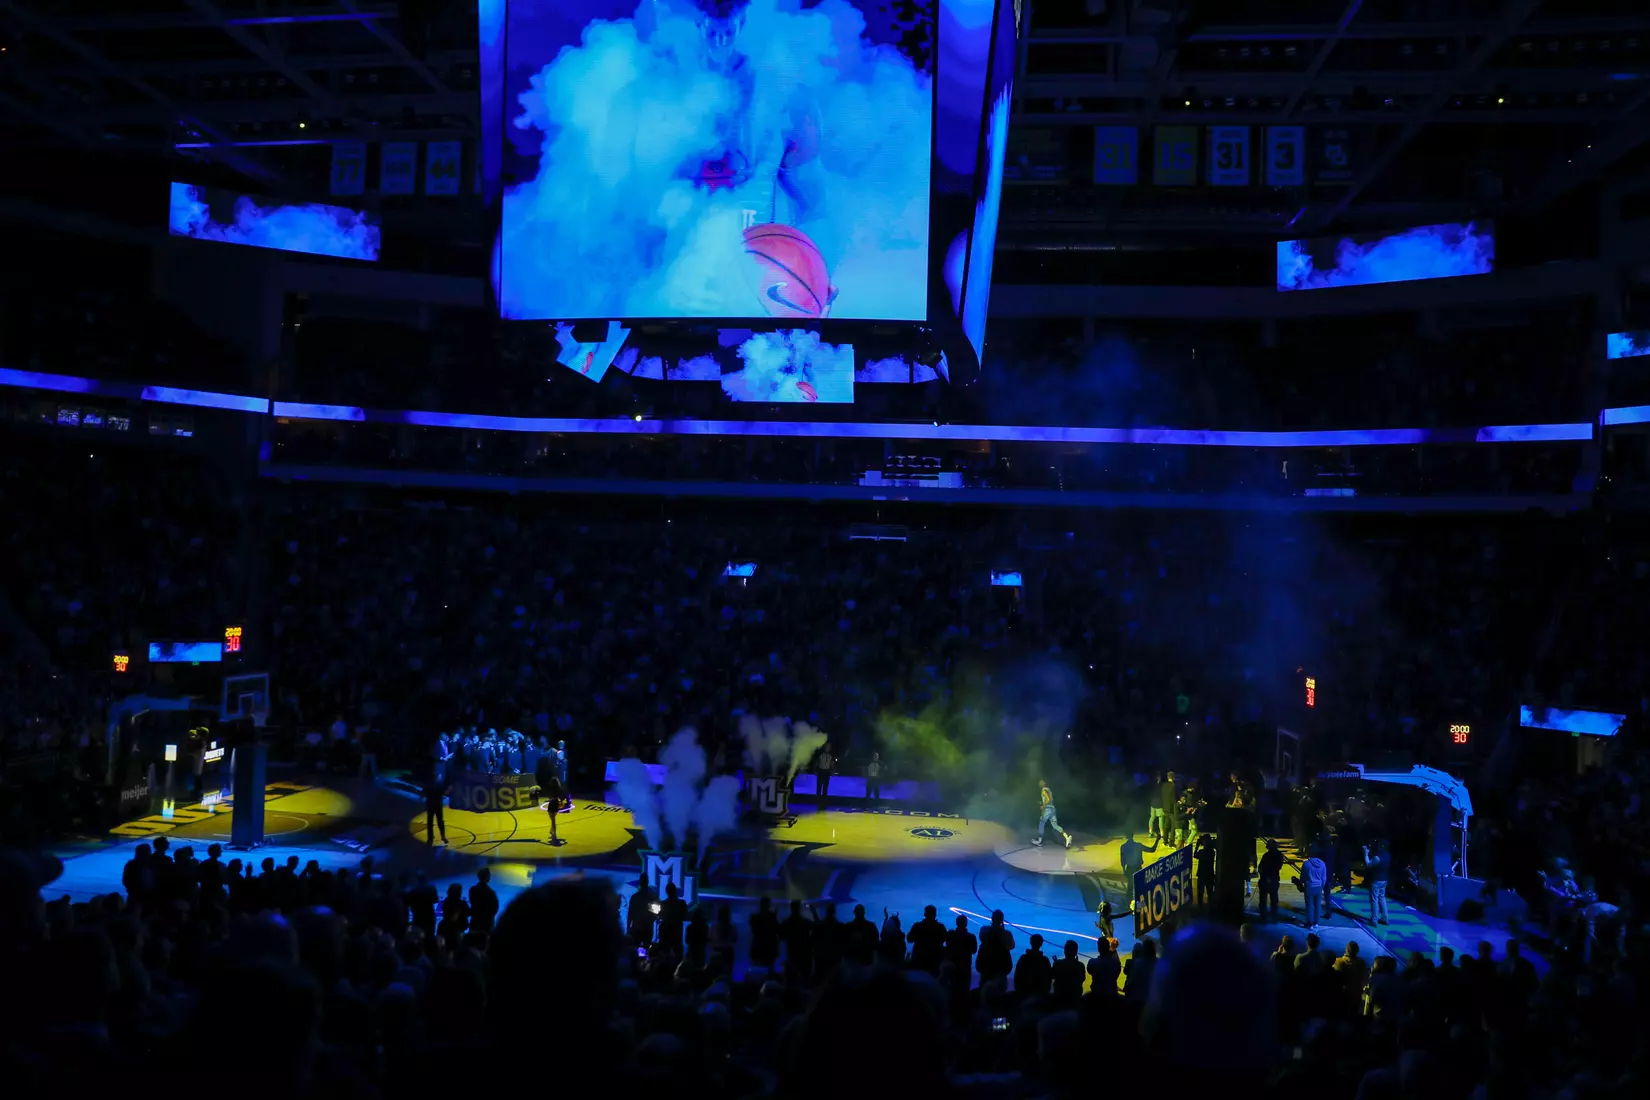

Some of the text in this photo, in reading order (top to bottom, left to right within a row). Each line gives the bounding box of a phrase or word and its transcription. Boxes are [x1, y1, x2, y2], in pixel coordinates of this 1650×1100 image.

[1100, 143, 1132, 169] 31
[1160, 142, 1194, 170] 15
[1216, 142, 1245, 169] 31
[1276, 143, 1295, 169] 3
[226, 637, 240, 652] 30
[116, 663, 126, 672] 30
[1454, 732, 1467, 743] 30
[121, 783, 149, 802] meijer
[492, 775, 520, 784] SOME
[453, 782, 532, 810] NOISE
[750, 777, 784, 814] MU
[1145, 851, 1184, 884] MAKE SOME
[1139, 867, 1190, 931] NOISE
